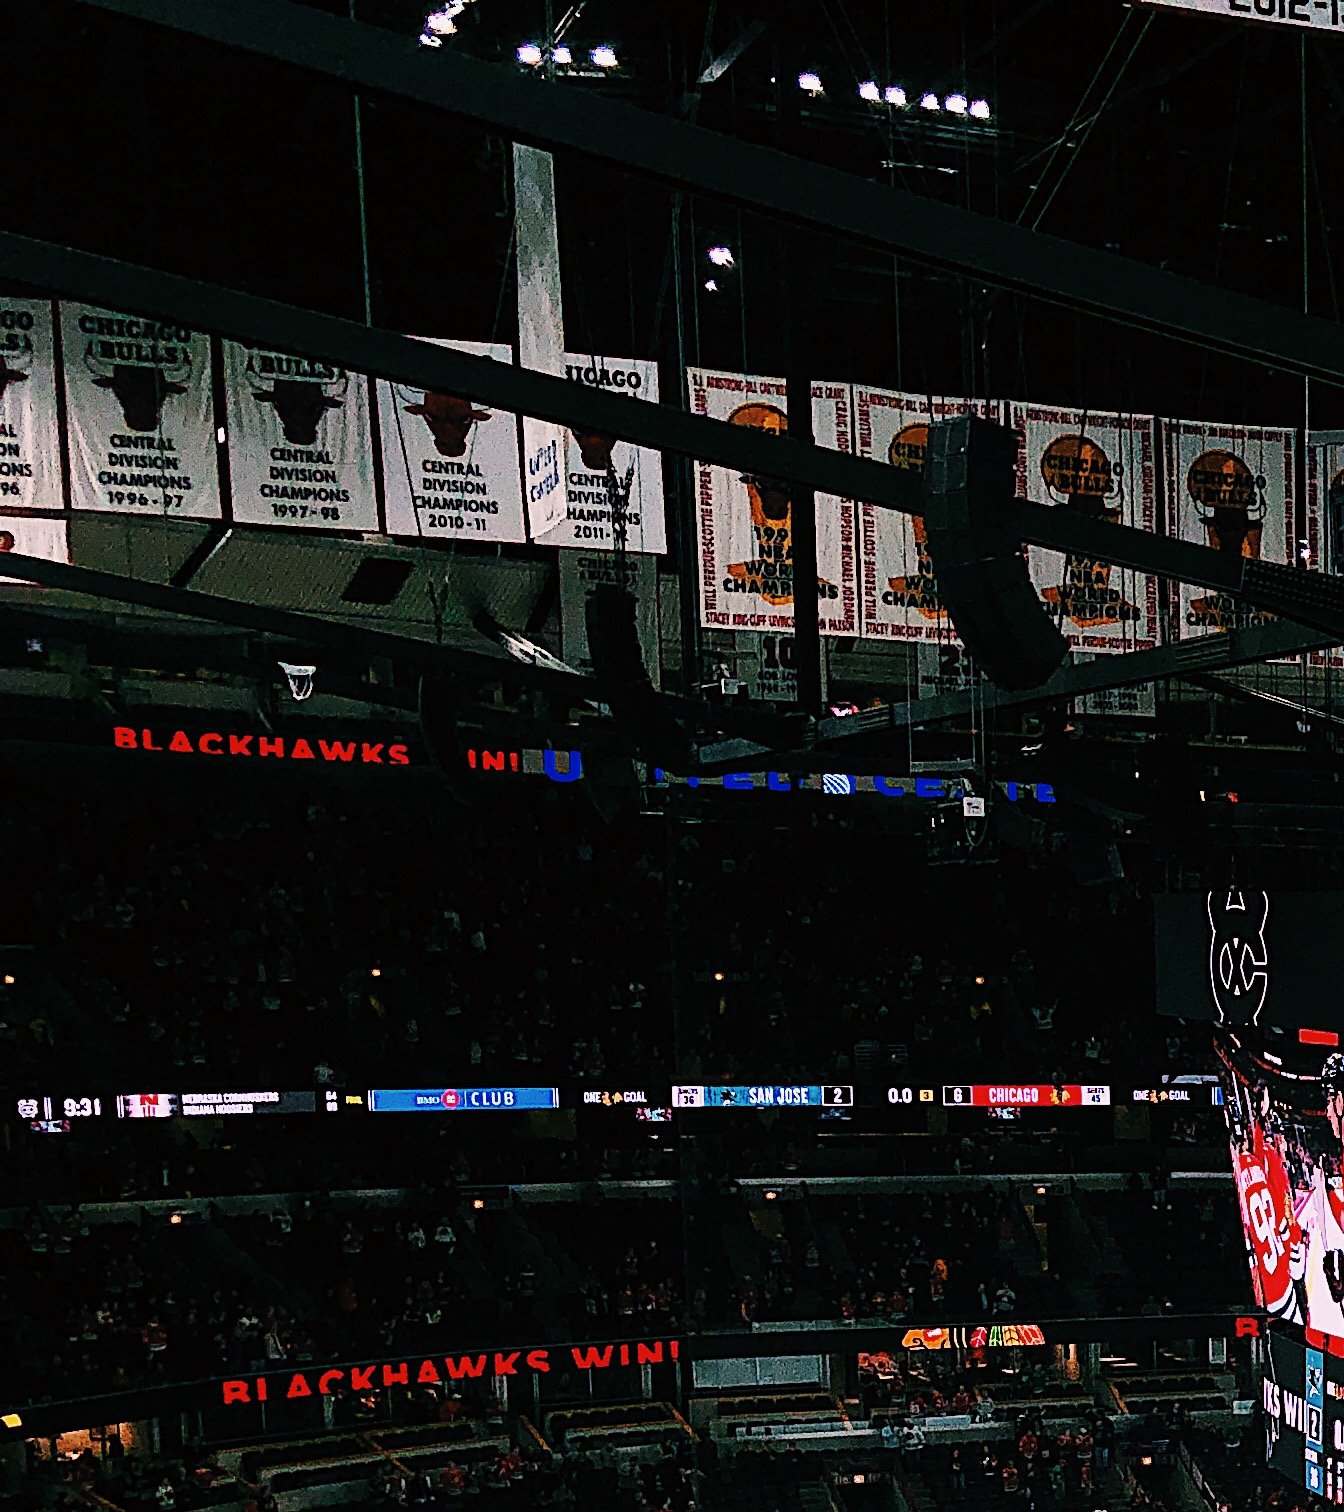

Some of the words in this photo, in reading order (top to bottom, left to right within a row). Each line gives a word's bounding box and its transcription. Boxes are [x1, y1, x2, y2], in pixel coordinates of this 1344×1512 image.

[260, 355, 336, 379] BULLS
[110, 434, 176, 450] CENTRAL
[108, 453, 178, 470] DIVISION
[271, 448, 334, 465] CENTRAL
[269, 466, 336, 483] DIVISION
[422, 459, 483, 478] CENTRAL
[99, 471, 192, 490] CHAMPIONS
[422, 478, 487, 496] DIVISION
[261, 484, 350, 503] CHAMPIONS
[415, 495, 499, 515] CHAMPIONS
[114, 727, 409, 765] BLACKHAWKS
[471, 1092, 514, 1107] CLUB
[584, 1092, 601, 1104] ONE
[624, 1091, 646, 1104] GOAL
[750, 1089, 774, 1104] SAN
[777, 1088, 808, 1103] JOSE
[834, 1089, 842, 1104] 2
[889, 1088, 912, 1104] 0.0
[954, 1089, 963, 1102] 6
[989, 1088, 1038, 1103] CHICAGO
[1169, 1090, 1190, 1102] GOAL
[571, 1341, 679, 1369] WIN!
[223, 1349, 550, 1405] BLACKHAWKS
